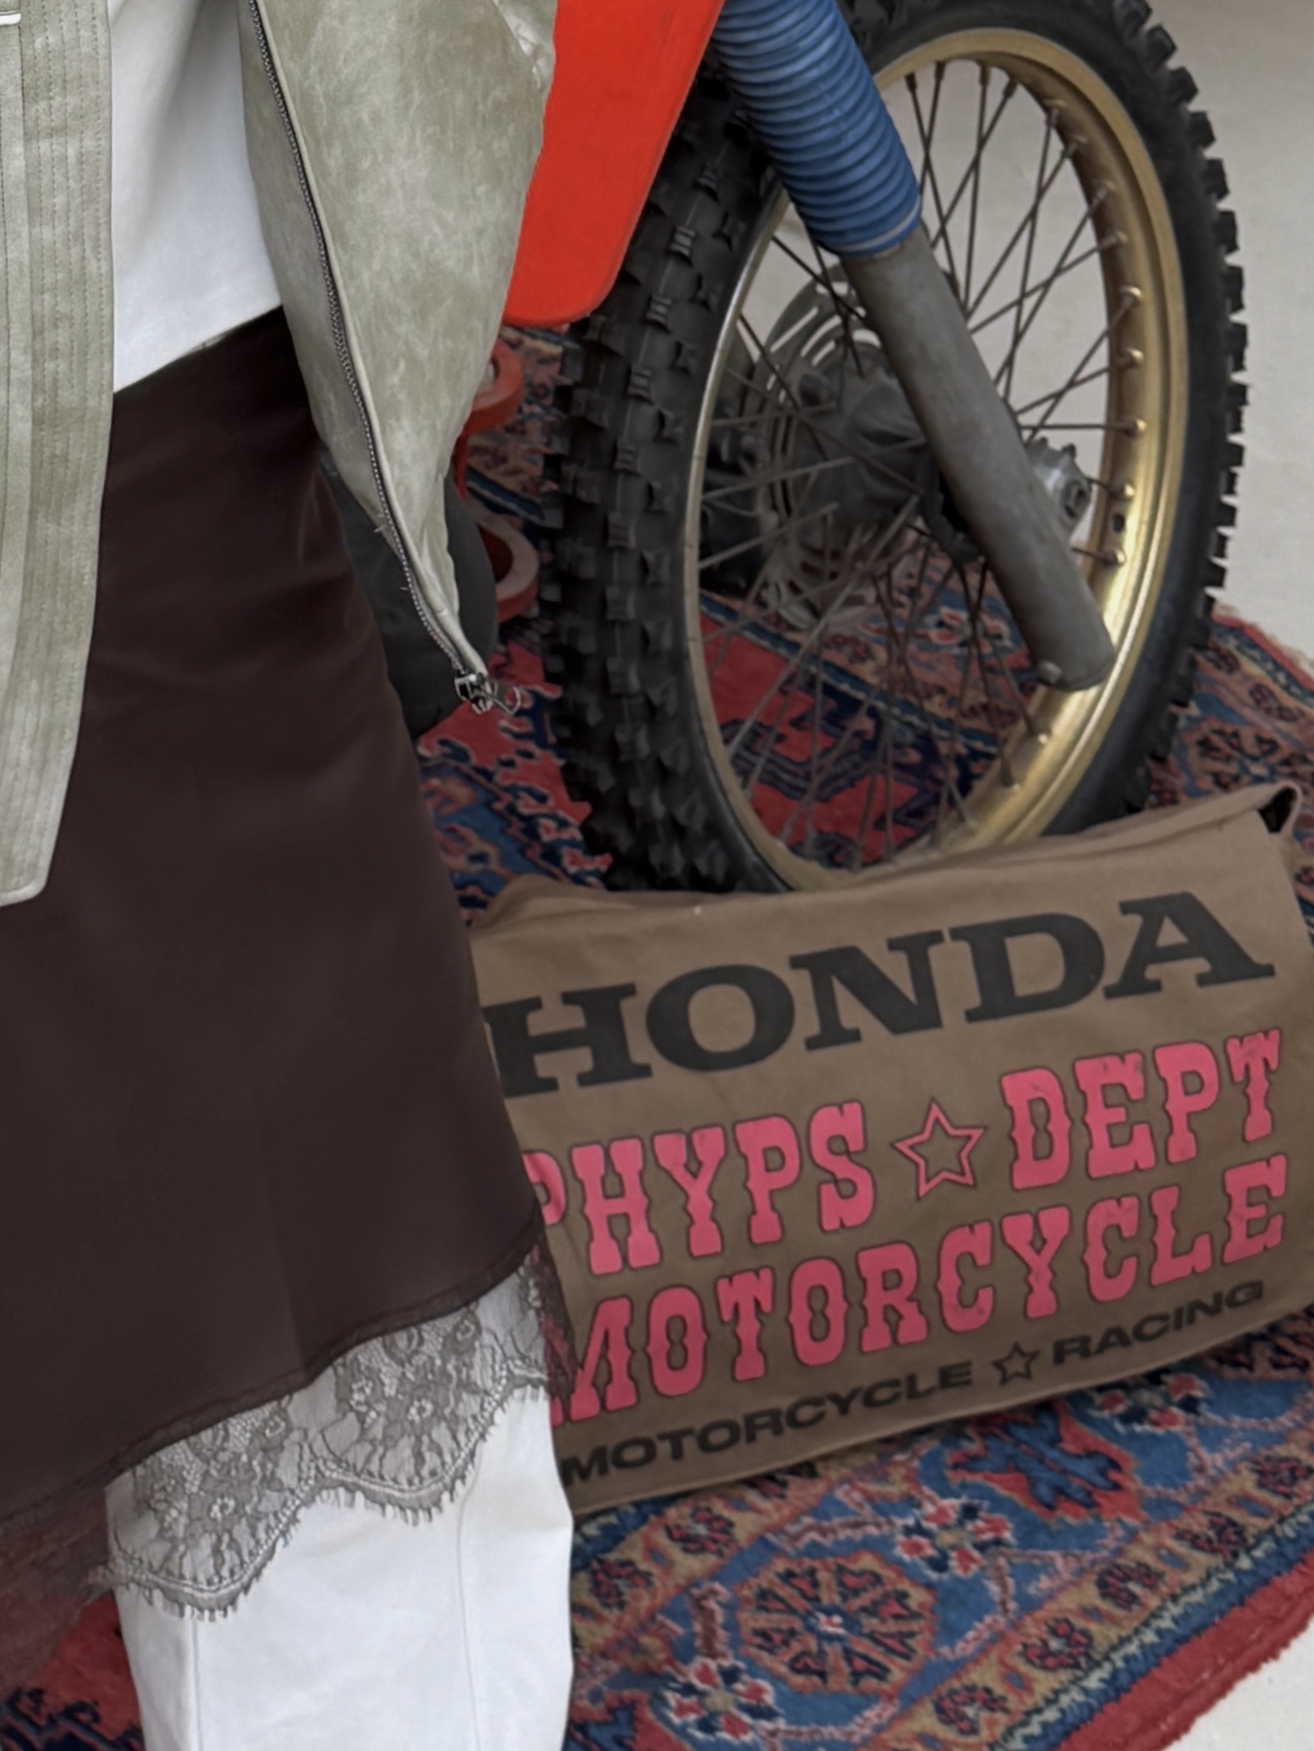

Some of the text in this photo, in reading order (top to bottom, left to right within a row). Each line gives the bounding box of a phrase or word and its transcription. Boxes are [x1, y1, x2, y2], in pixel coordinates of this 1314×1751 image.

[483, 892, 1275, 1099] HONDA
[1001, 1028, 1282, 1190] DEPT
[561, 1279, 1265, 1487] MOTORCYCLE RACING
